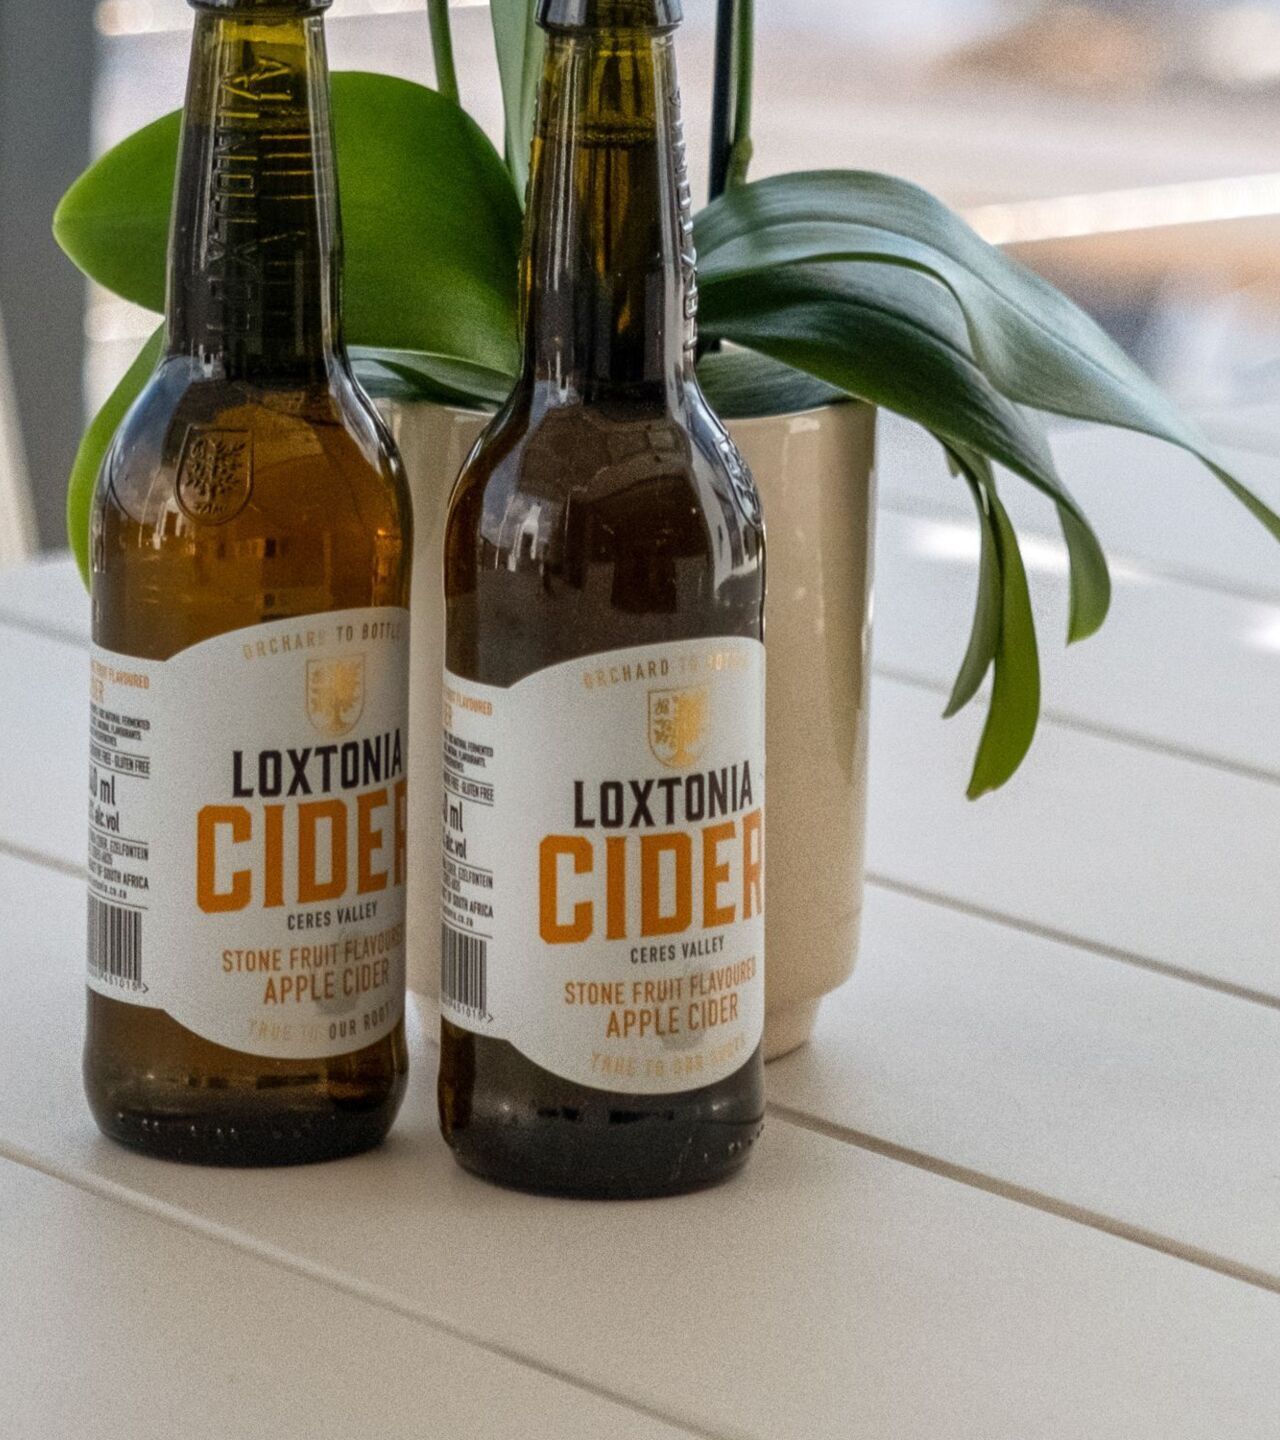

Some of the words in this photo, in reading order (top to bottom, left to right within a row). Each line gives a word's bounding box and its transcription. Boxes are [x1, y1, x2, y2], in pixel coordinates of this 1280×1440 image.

[336, 624, 354, 643] TO
[582, 657, 670, 690] ORCHARD
[135, 759, 151, 775] FREE
[232, 728, 403, 798] LOXTONIA
[99, 774, 116, 806] ml
[480, 785, 494, 802] FREE
[573, 760, 753, 829] LOXTONIA
[449, 801, 464, 832] ml
[196, 778, 408, 915] CIDER
[123, 874, 150, 890] AFRICA
[539, 808, 764, 945] CIDER
[287, 910, 331, 931] CERES
[336, 900, 378, 926] VALLEY
[470, 900, 494, 919] AFRICA
[222, 948, 281, 973] STONE
[289, 943, 339, 970] FRUIT
[630, 944, 676, 965] CERES
[681, 934, 726, 960] VALLEY
[263, 971, 336, 1006] APPLE
[343, 957, 391, 997] CIDER
[564, 981, 625, 1006] STONE
[632, 977, 682, 1005] FRUIT
[690, 955, 758, 998] FLAVOURED
[328, 1018, 357, 1041] OUR
[605, 1006, 679, 1040] APPLE
[687, 992, 740, 1031] CIDER
